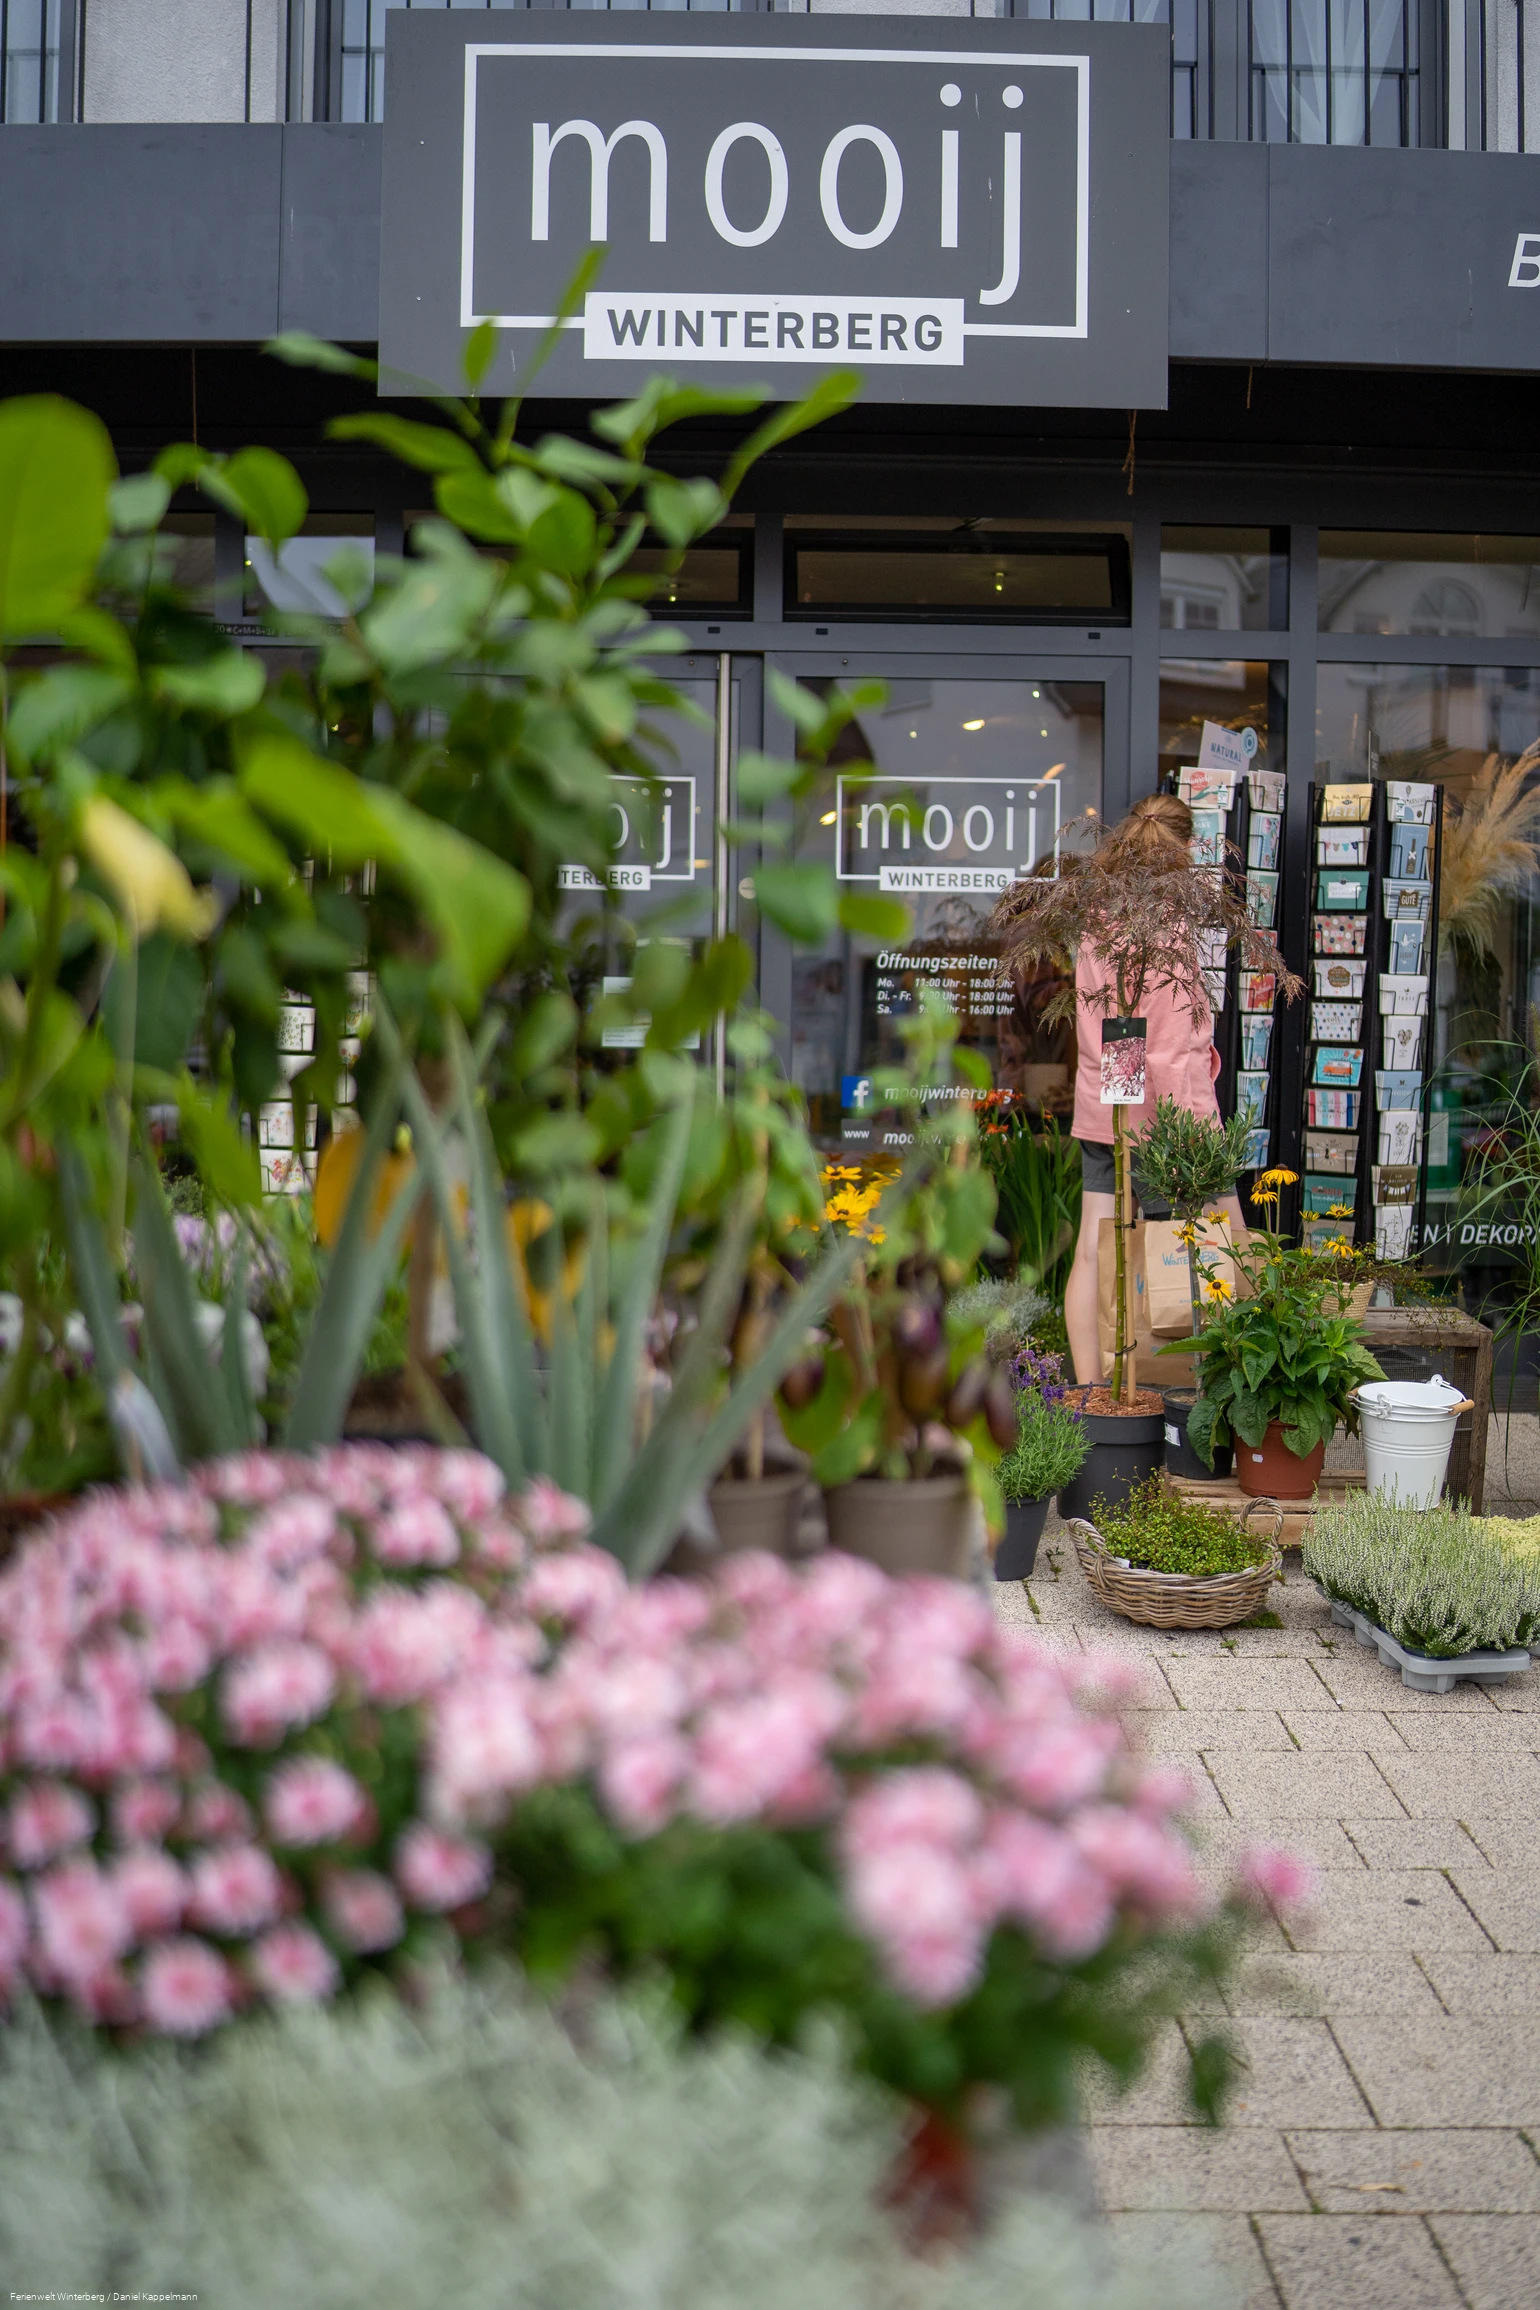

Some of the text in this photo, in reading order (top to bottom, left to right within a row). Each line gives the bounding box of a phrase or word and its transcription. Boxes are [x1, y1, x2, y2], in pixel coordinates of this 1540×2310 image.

[531, 83, 1024, 306] mooij
[606, 308, 944, 352] WINTERBERG
[1211, 742, 1242, 763] NATURAL
[859, 790, 1038, 872] mooij
[887, 873, 1009, 888] WINTERBERG
[877, 978, 895, 988] Mo.
[915, 978, 941, 988] 11:00
[942, 978, 961, 988] Uhr
[970, 978, 996, 988] 18:00
[877, 991, 890, 1001] Di.
[900, 991, 912, 1001] Fr.
[942, 991, 961, 1001] Uhr
[970, 991, 996, 1002] 18:00
[997, 991, 1016, 1002] Uhr
[877, 1004, 893, 1014] Sa.
[969, 1004, 995, 1015] 16:00
[997, 1005, 1016, 1015] Uhr
[844, 1130, 870, 1139] www
